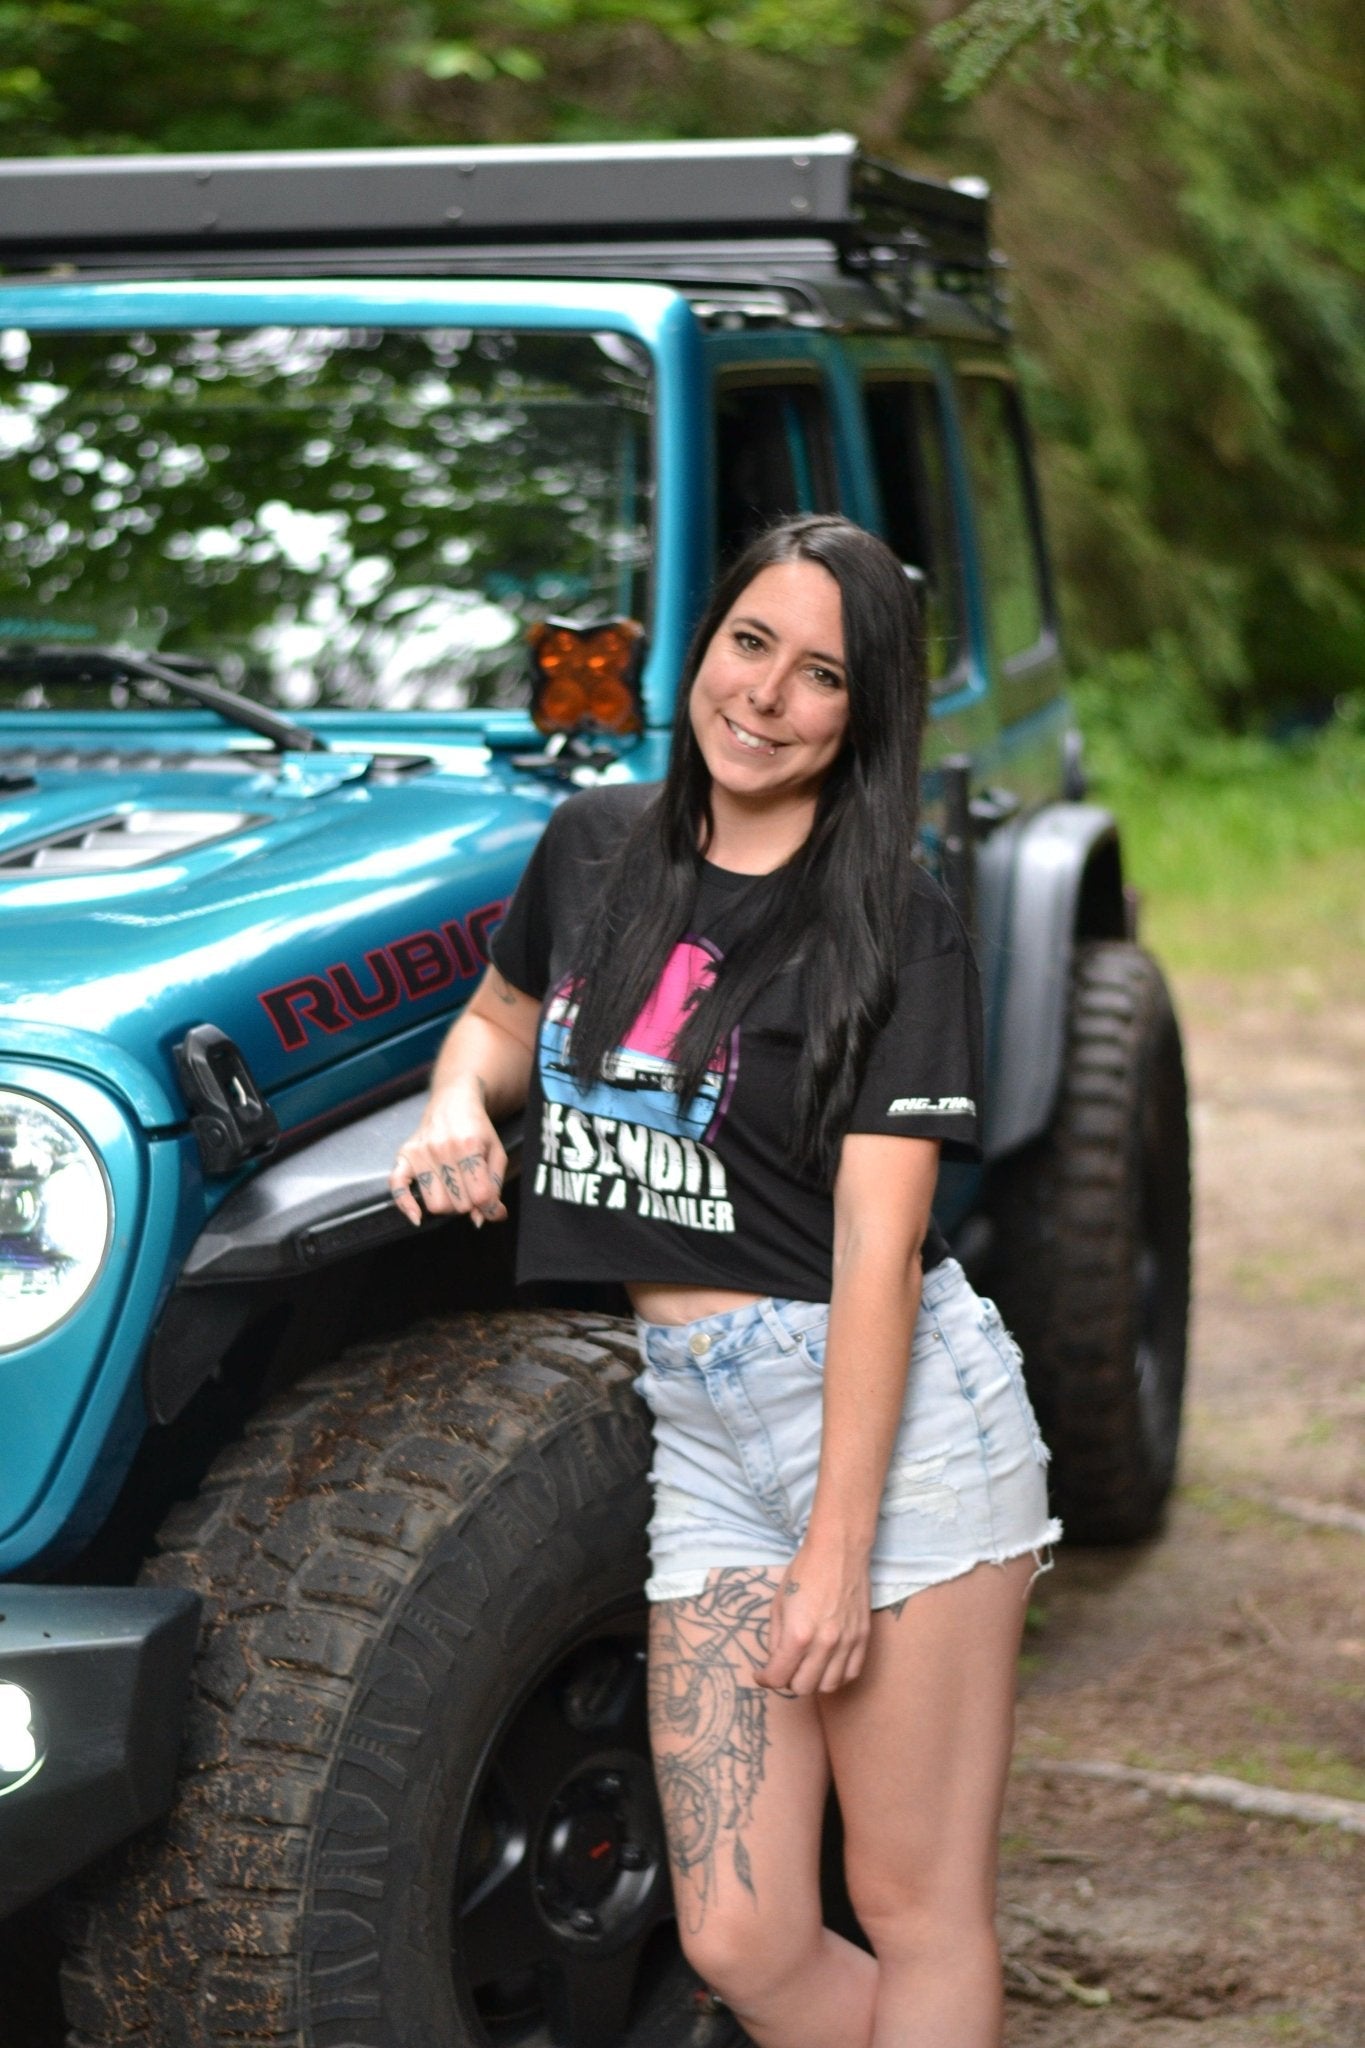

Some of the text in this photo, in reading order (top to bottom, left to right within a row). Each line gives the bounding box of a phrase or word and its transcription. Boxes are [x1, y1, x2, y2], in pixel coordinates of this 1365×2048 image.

[257, 897, 514, 1052] RUBIC
[534, 1163, 548, 1196] I
[606, 1178, 627, 1210] A
